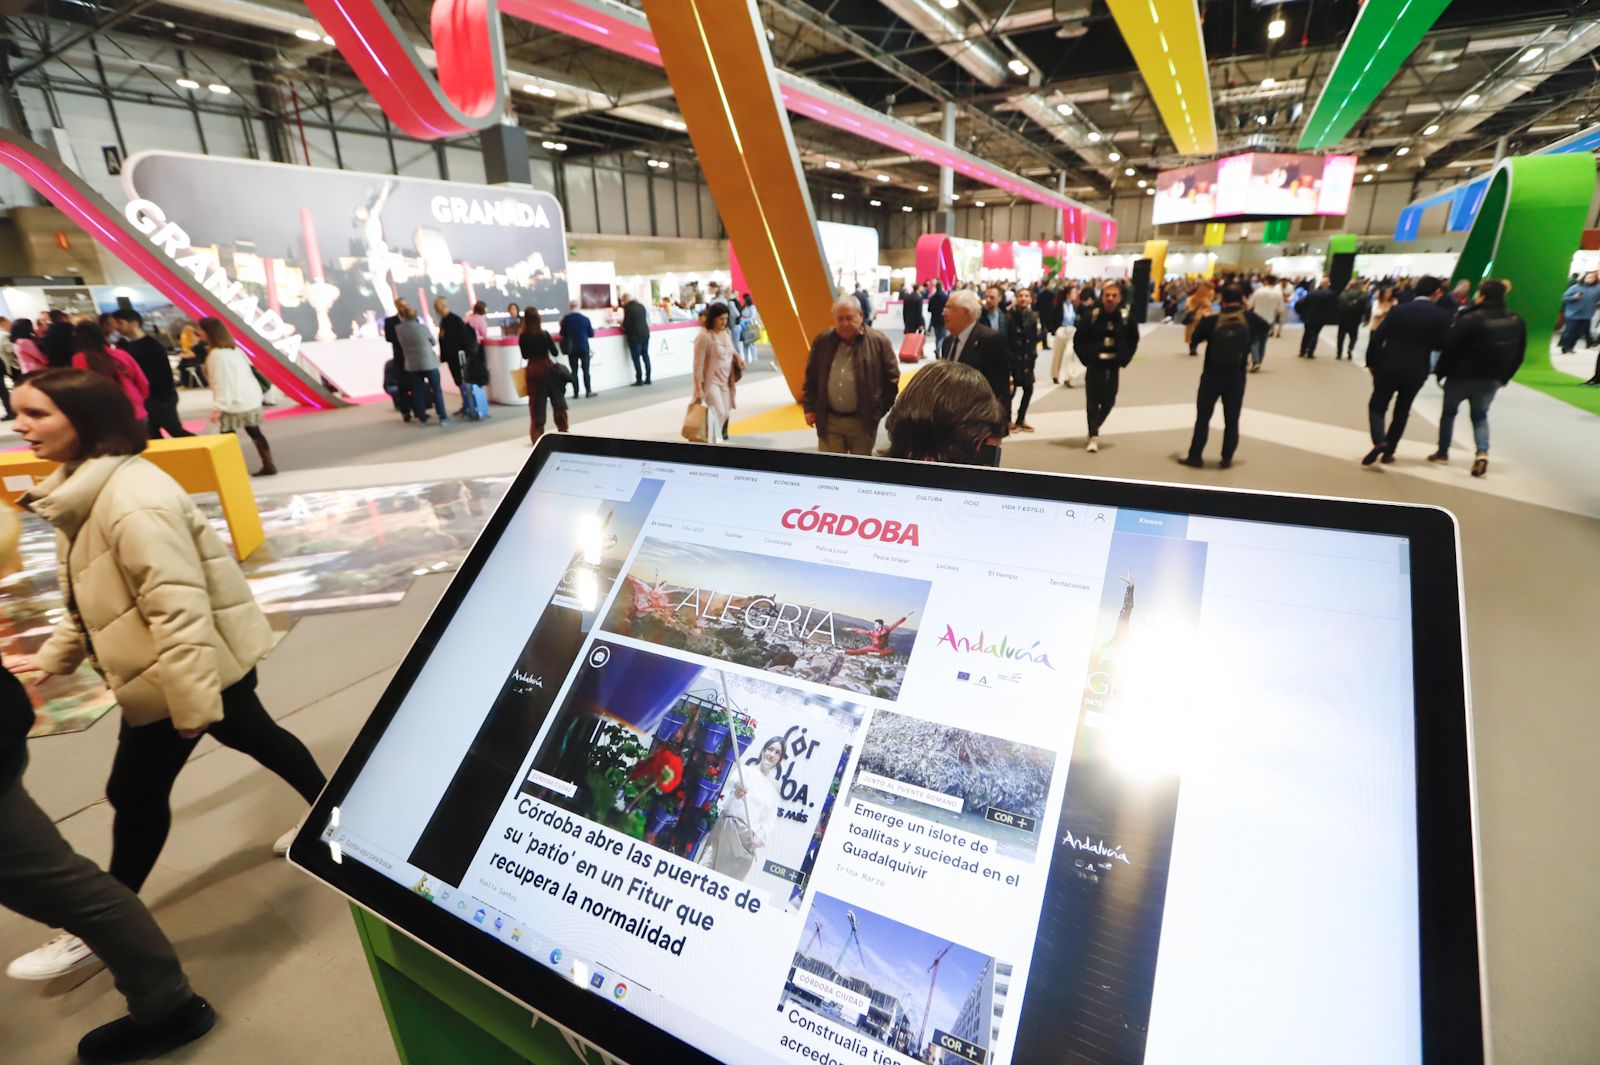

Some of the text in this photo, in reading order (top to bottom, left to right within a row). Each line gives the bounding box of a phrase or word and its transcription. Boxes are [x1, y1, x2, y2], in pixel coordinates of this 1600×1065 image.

[431, 195, 550, 228] GRANADA
[124, 198, 302, 363] GRANADA
[873, 490, 897, 498] ABIERTO
[915, 494, 943, 503] CULTURA
[1001, 503, 1016, 512] VIDA
[1022, 506, 1045, 514] ESTILO
[781, 505, 920, 547] CÓRDOBA
[936, 562, 960, 572] Locales
[997, 571, 1018, 581] tiempo
[1049, 578, 1091, 592] Tentaciones
[936, 623, 1056, 671] Andalucía
[862, 775, 886, 788] JUNTO
[896, 785, 924, 798] PUENTE
[926, 792, 957, 808] ROMANO
[854, 803, 989, 855] Emerge un islote de
[993, 811, 1014, 825] COR
[517, 798, 762, 914] Córdoba abre las puertas de
[842, 841, 928, 880] Guadalquivir
[849, 822, 1020, 888] toallitas y suciedad en el
[1062, 830, 1132, 865] Andalucía
[503, 824, 714, 932] su 'patio' en un Fitur que
[769, 864, 786, 877] COR
[835, 863, 886, 888] Irina Marzo
[489, 851, 687, 957] recupera la normalidad
[835, 990, 864, 1008] CIUDAD
[788, 1009, 869, 1059] Construalia
[940, 1035, 963, 1052] COR
